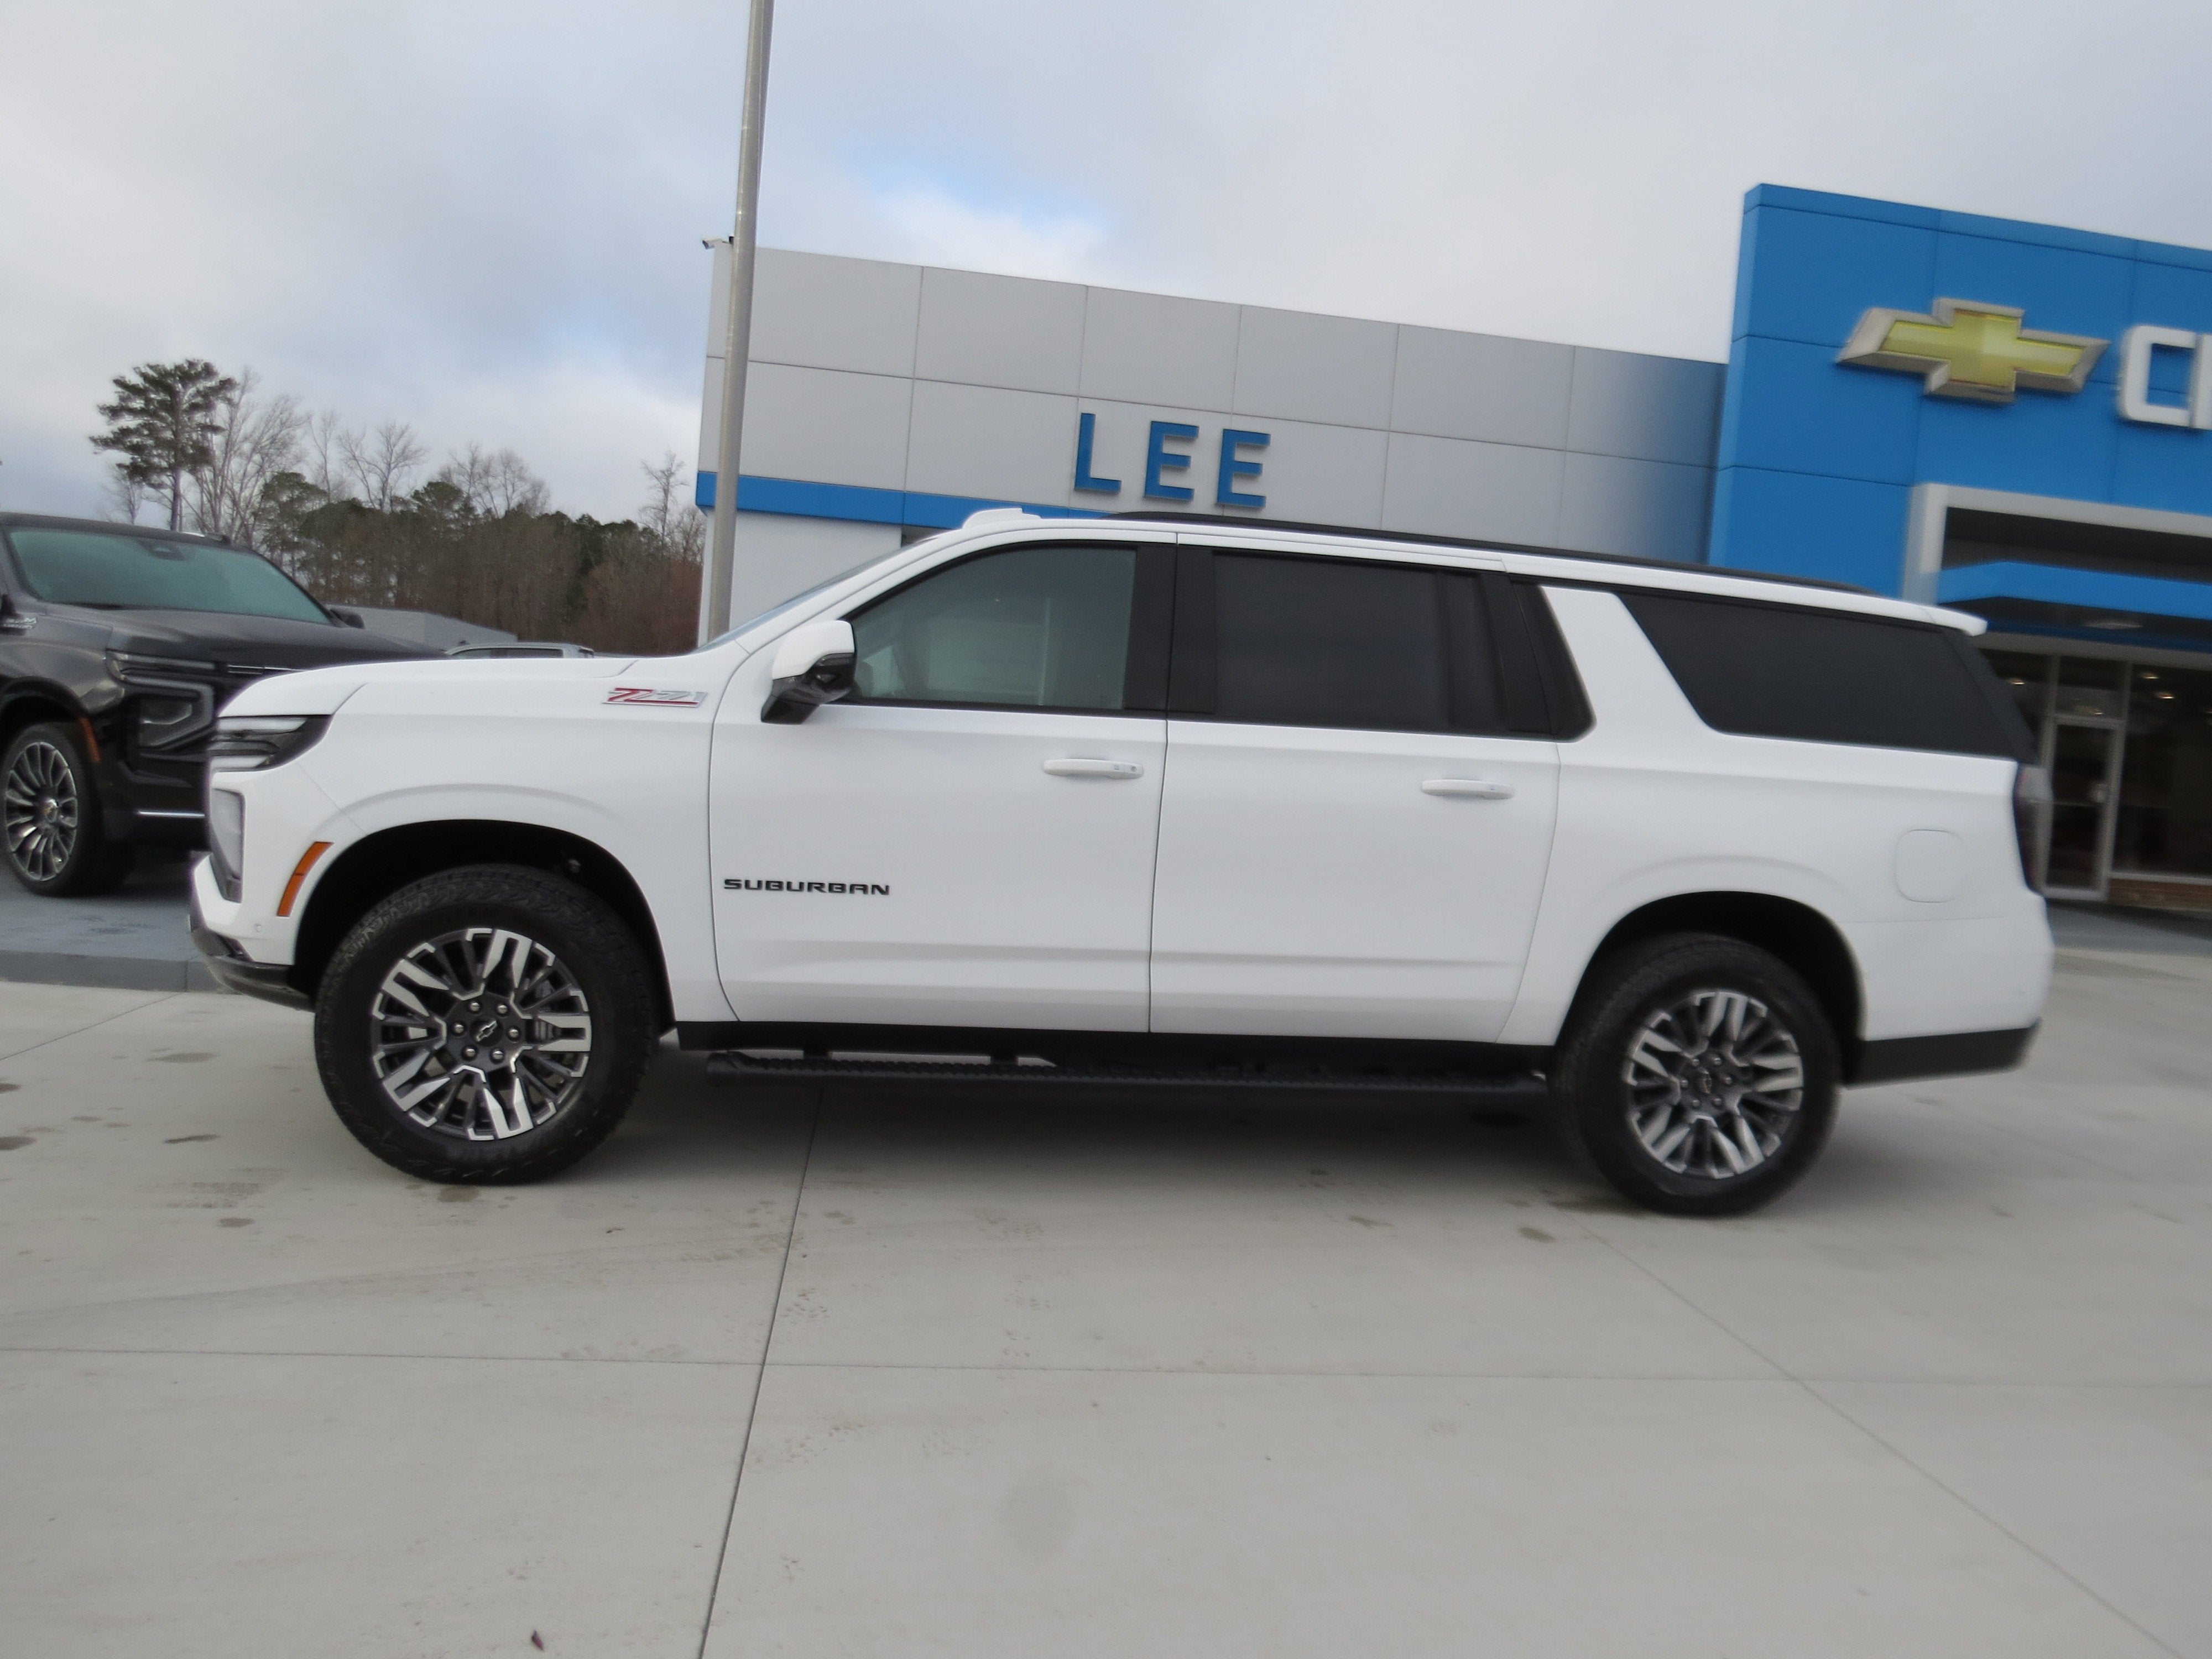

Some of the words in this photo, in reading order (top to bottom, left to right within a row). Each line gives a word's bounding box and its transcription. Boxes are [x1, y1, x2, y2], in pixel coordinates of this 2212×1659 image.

[2119, 325, 2212, 430] C
[1074, 413, 1271, 508] LEE
[606, 687, 708, 707] Z71
[724, 879, 890, 896] SUBURBAN
